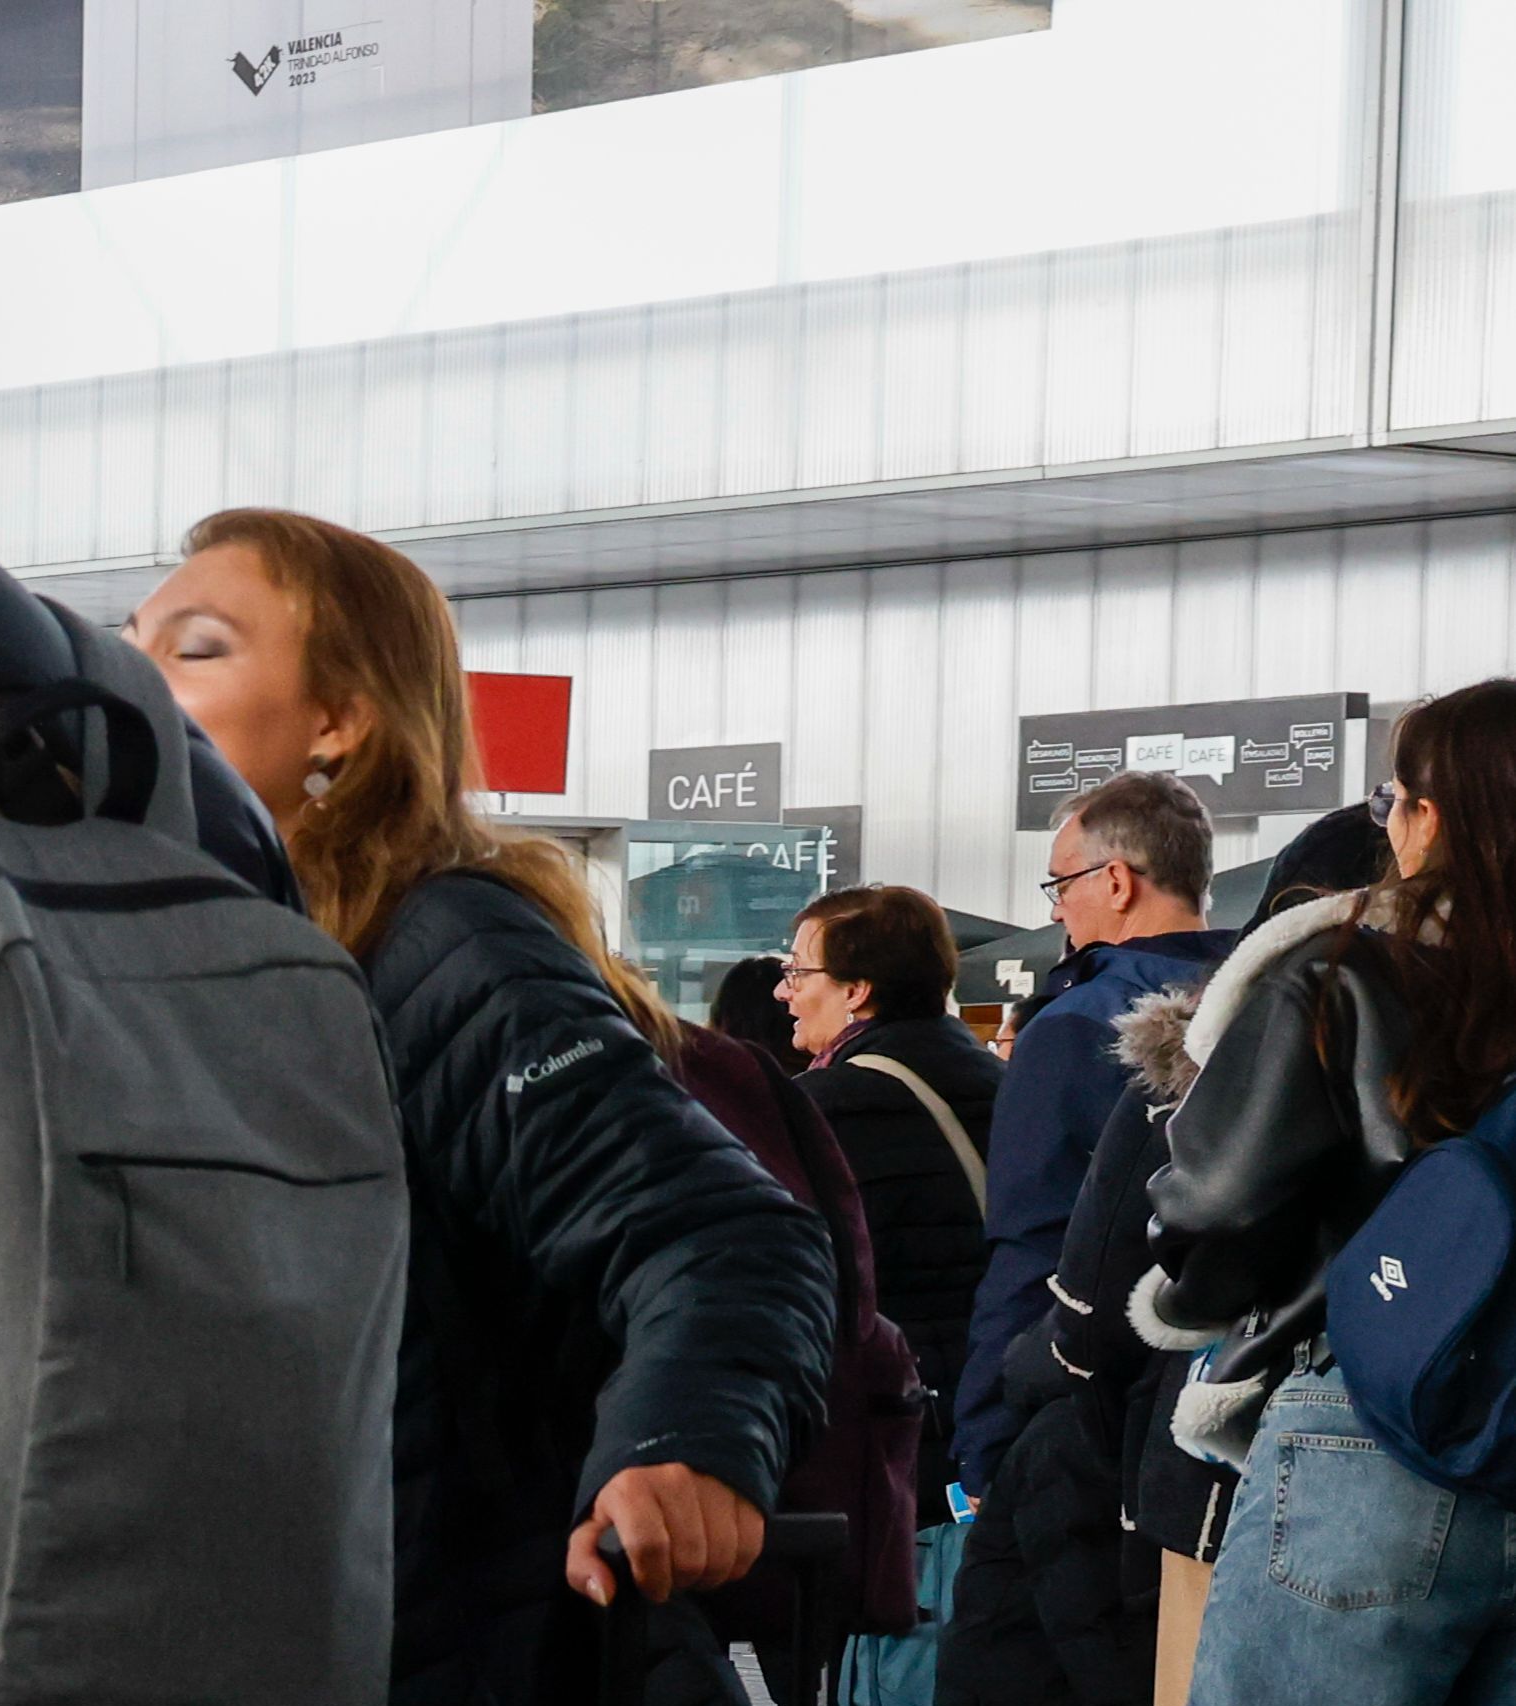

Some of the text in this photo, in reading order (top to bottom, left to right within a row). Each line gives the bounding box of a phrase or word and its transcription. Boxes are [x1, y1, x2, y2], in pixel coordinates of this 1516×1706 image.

[288, 32, 342, 55] VALENCIA
[288, 39, 378, 70] TRINIDAD ALFONSO
[289, 71, 315, 87] 2023
[1136, 745, 1174, 760] CAFÉ
[668, 762, 757, 810] CAFÉ
[524, 1035, 604, 1085] Columbia
